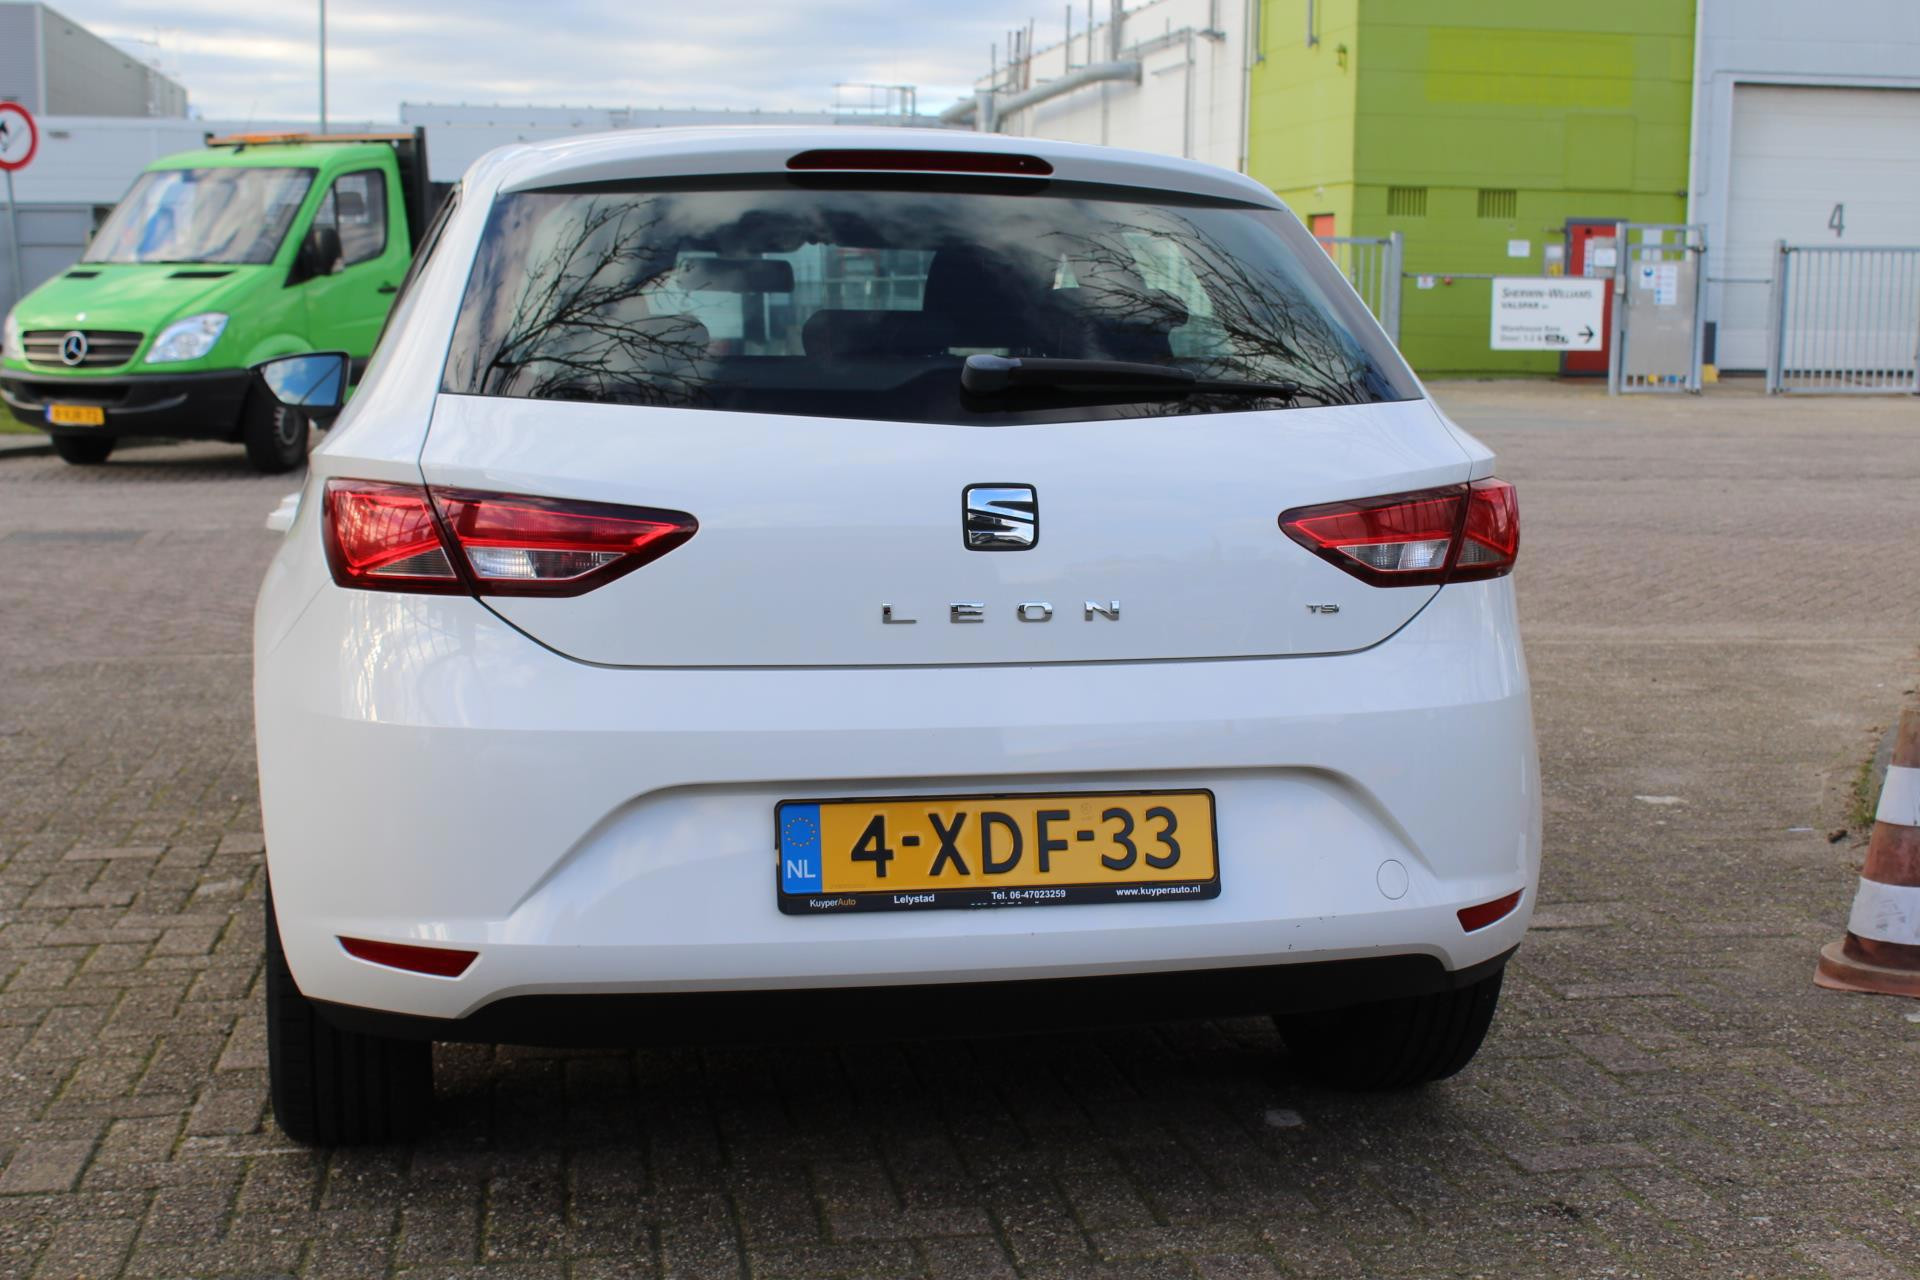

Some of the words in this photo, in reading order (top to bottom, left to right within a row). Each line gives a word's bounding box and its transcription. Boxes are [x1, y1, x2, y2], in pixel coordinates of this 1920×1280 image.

[1828, 204, 1845, 238] 4
[882, 600, 1120, 624] LEON
[851, 807, 1181, 878] 4-XDF-33
[786, 859, 816, 879] NL
[809, 898, 857, 909] KuyperAuto
[893, 893, 935, 905] Lelystad
[991, 891, 1008, 900] Tel.
[1010, 889, 1066, 900] 06-47023259
[1116, 885, 1201, 897] www.kuyperauto.nl
